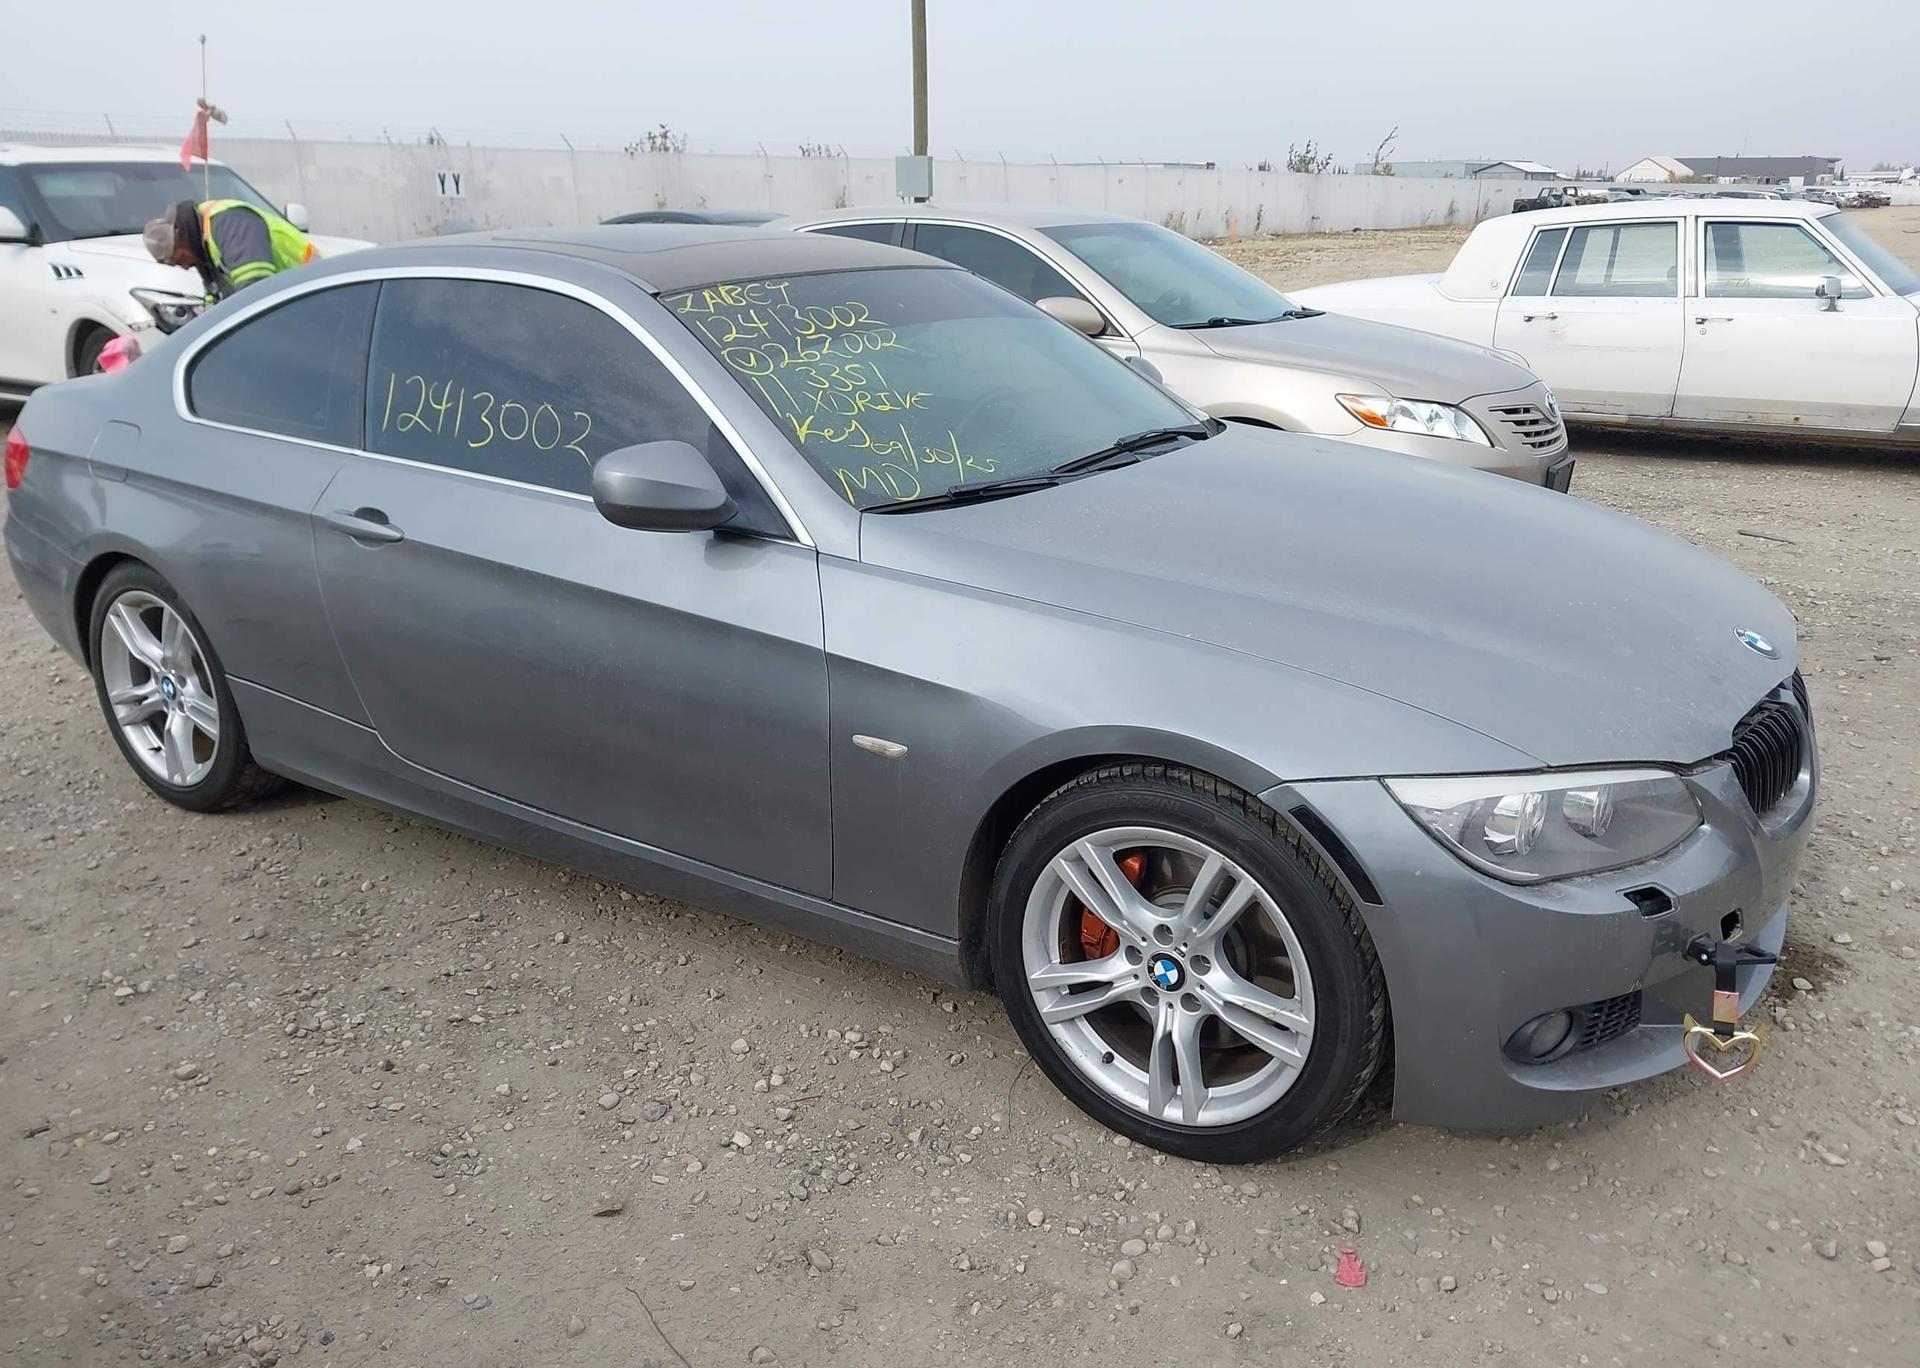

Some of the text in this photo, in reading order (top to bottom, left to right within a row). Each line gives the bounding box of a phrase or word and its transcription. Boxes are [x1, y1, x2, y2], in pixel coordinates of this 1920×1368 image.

[696, 301, 888, 348] 12413002
[382, 373, 592, 467] 12413002
[833, 463, 920, 504] MD
